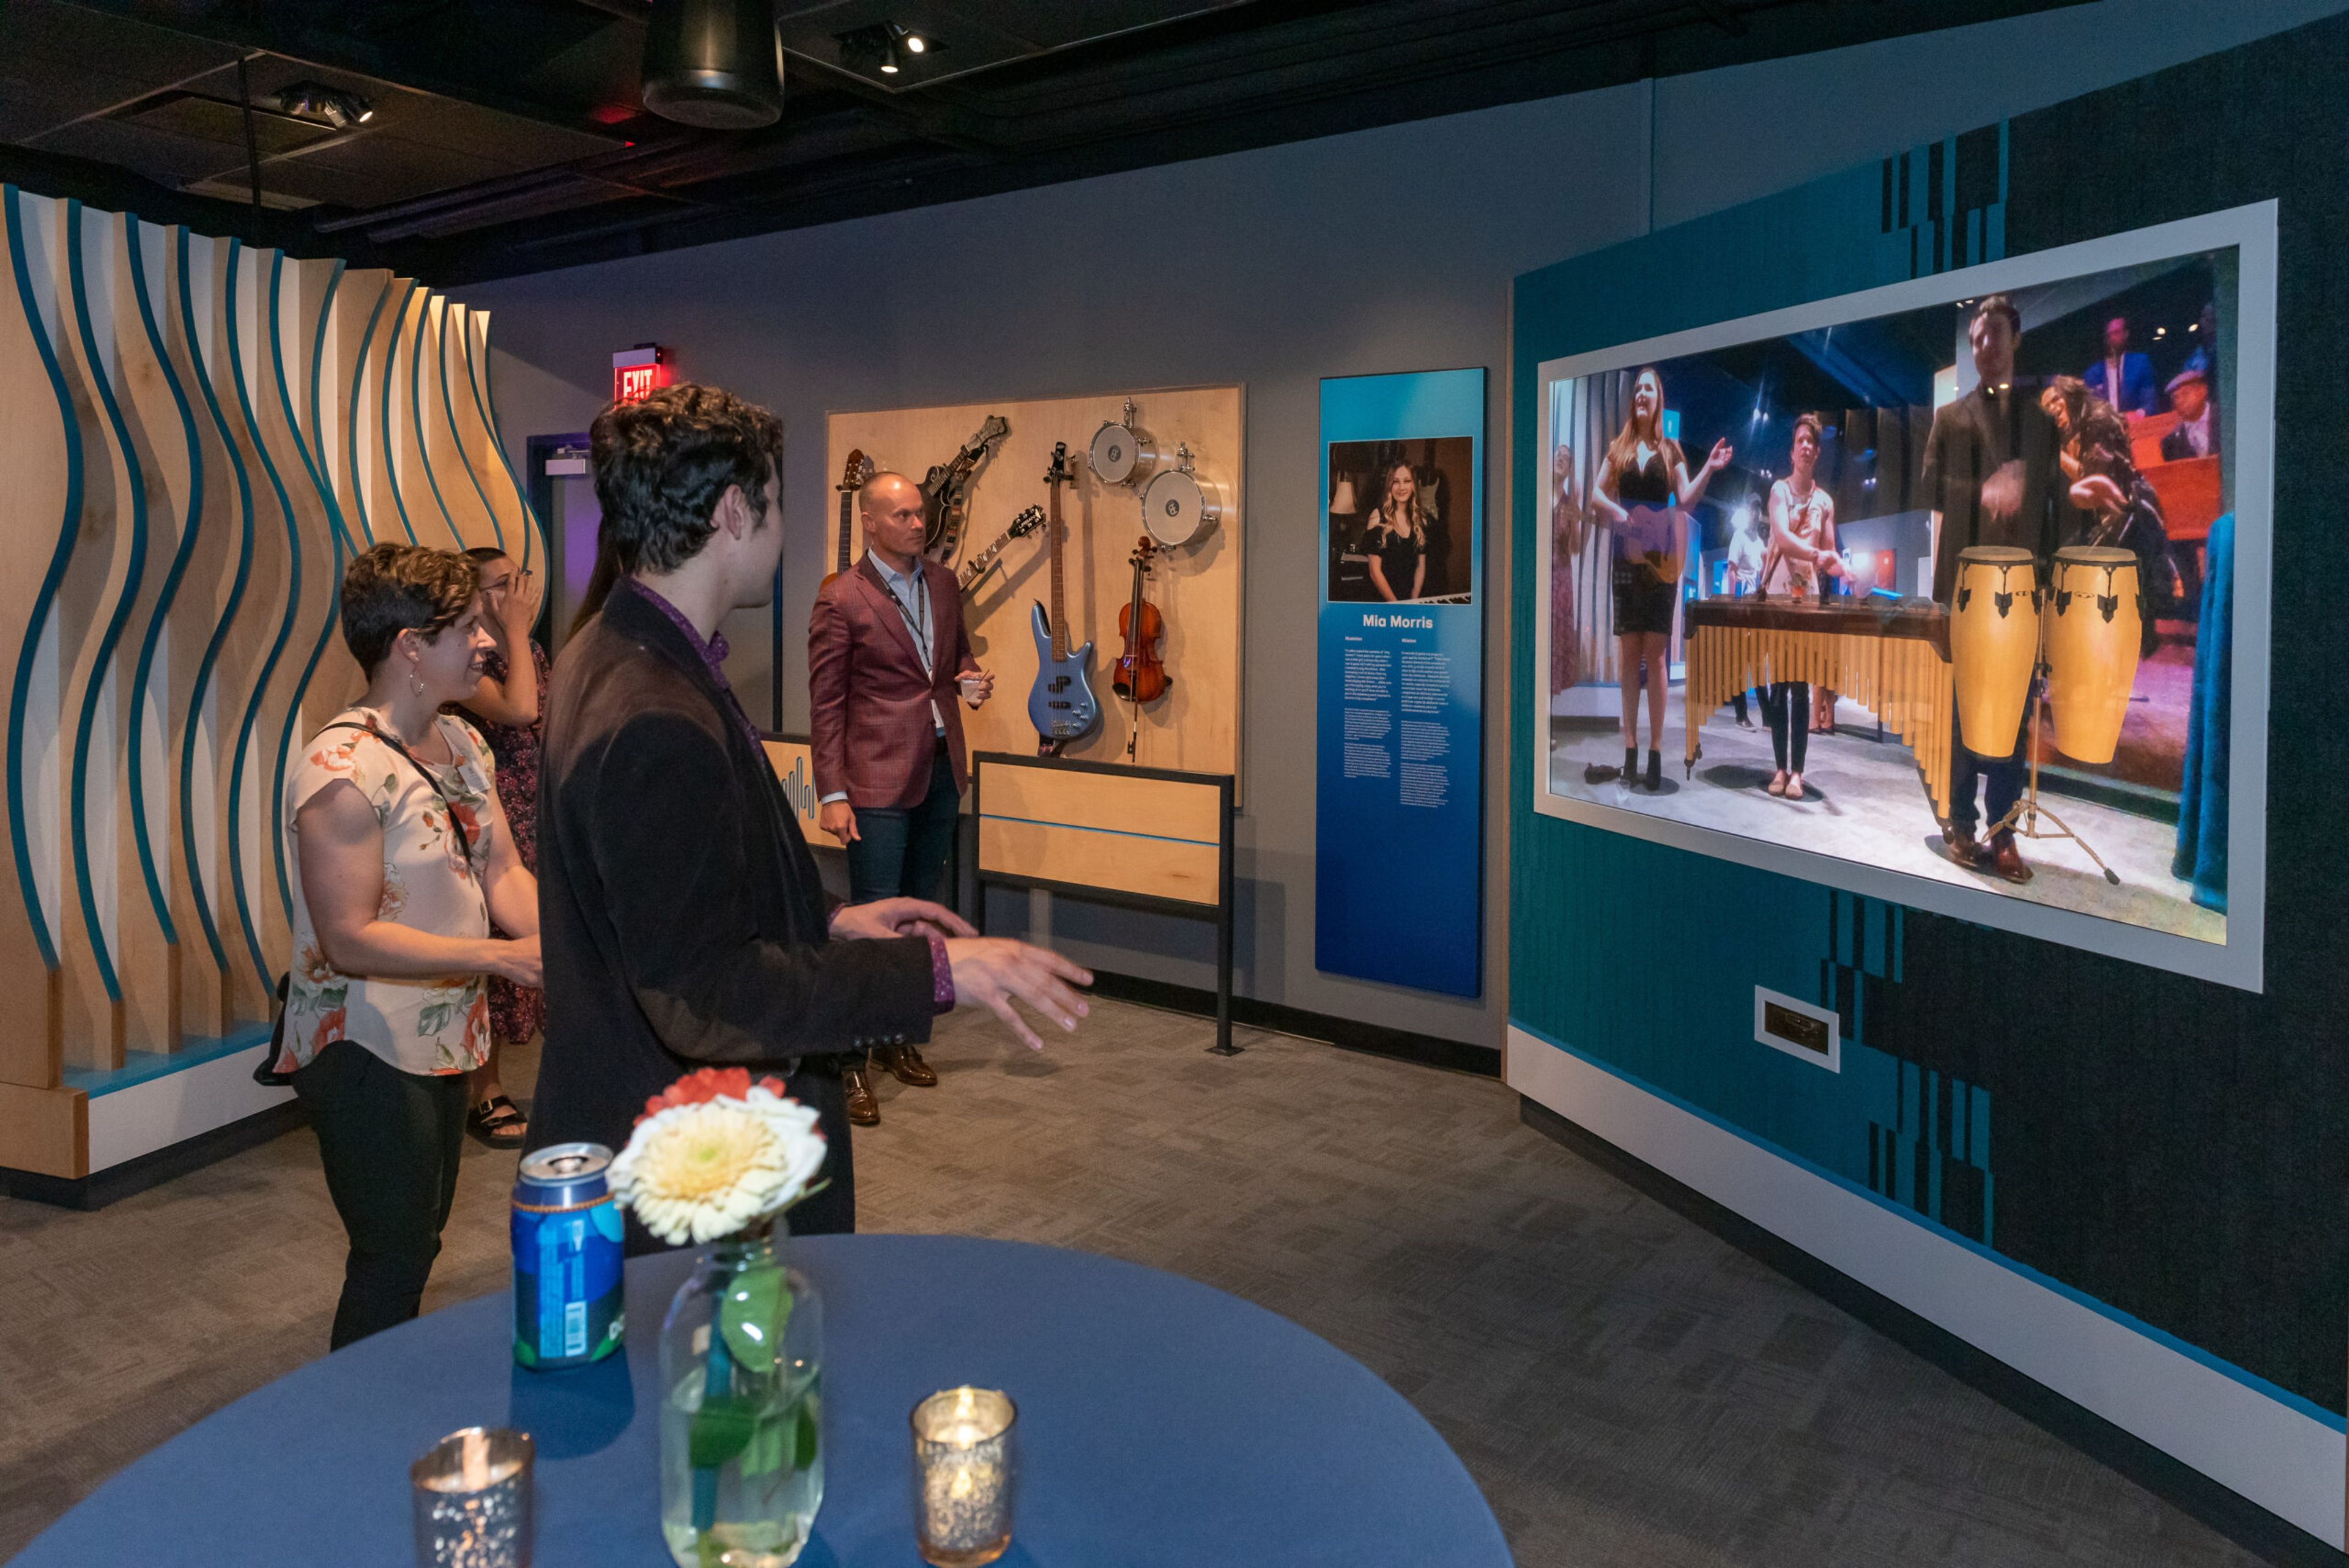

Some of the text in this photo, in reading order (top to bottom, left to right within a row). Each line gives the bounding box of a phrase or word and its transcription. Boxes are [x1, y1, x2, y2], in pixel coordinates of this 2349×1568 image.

[623, 369, 653, 399] EXIT
[1363, 615, 1433, 629] Mia Morris
